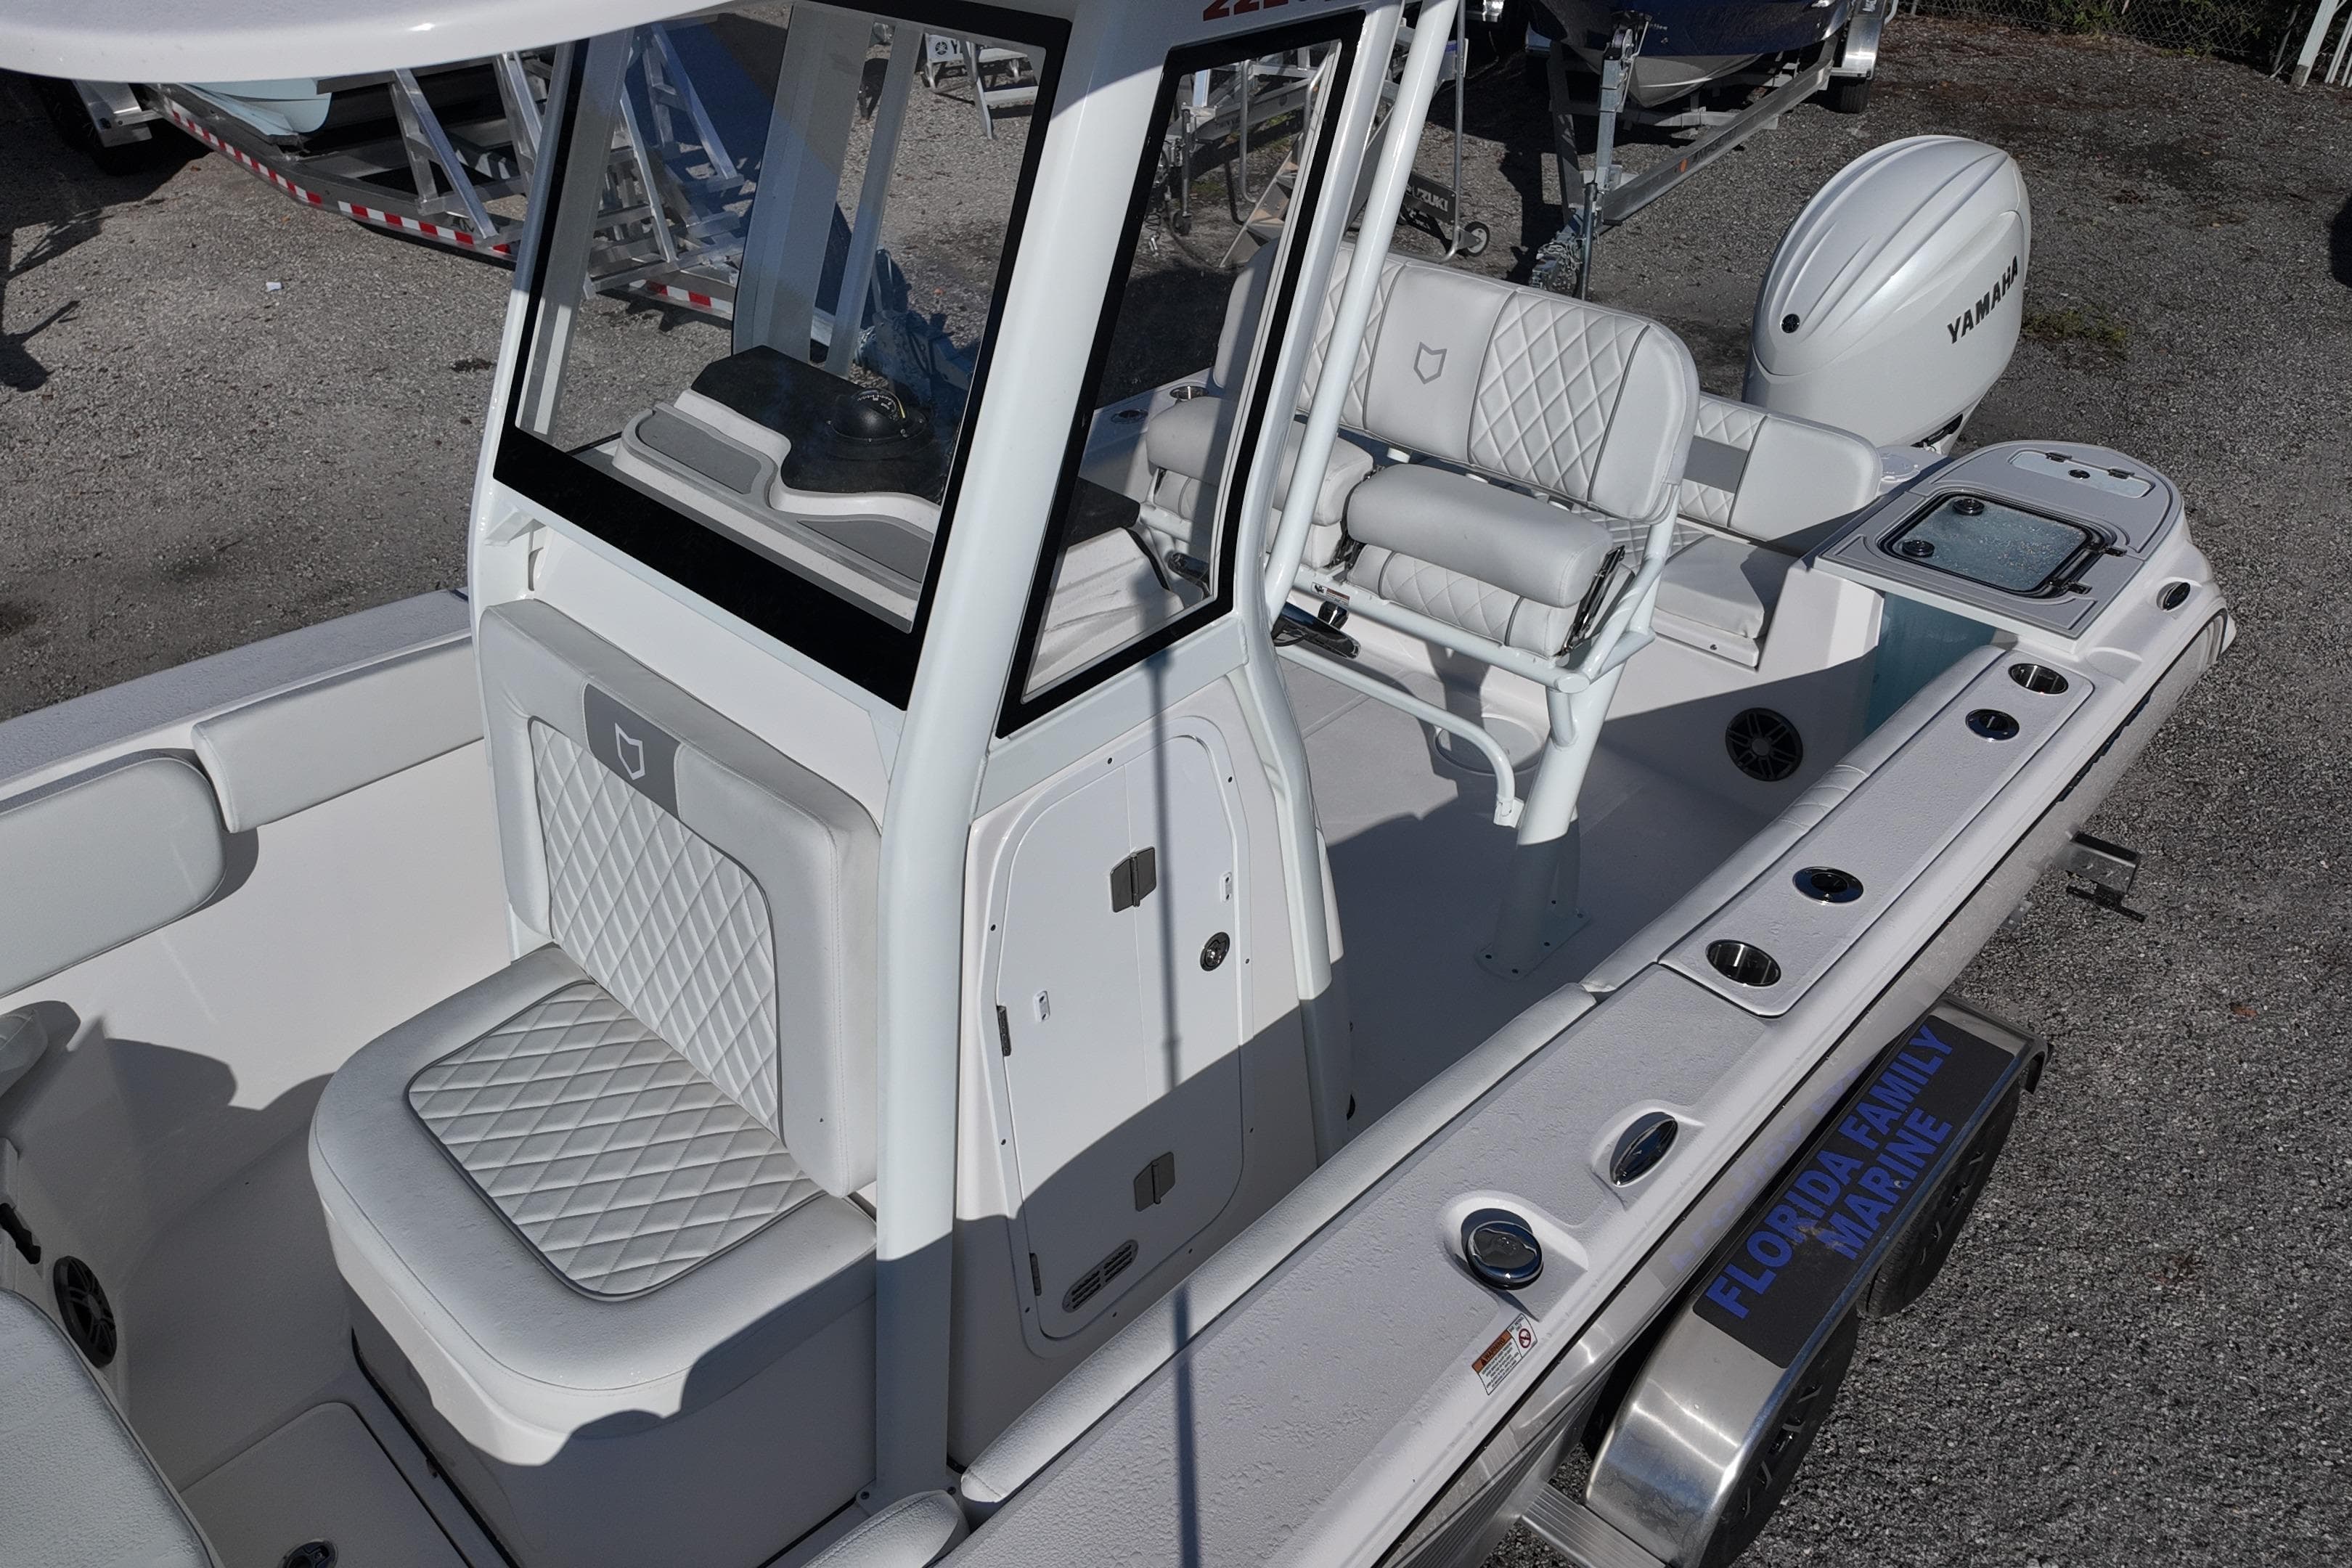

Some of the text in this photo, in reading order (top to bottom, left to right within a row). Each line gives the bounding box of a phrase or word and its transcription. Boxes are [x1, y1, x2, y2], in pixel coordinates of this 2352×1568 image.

[1947, 255, 2018, 344] YAMAHA
[1706, 1150, 1863, 1319] FLORIDA
[1838, 1025, 1953, 1150] FAMILY
[1816, 1108, 1953, 1260] MARINE
[1485, 1337, 1506, 1362] WARNING
